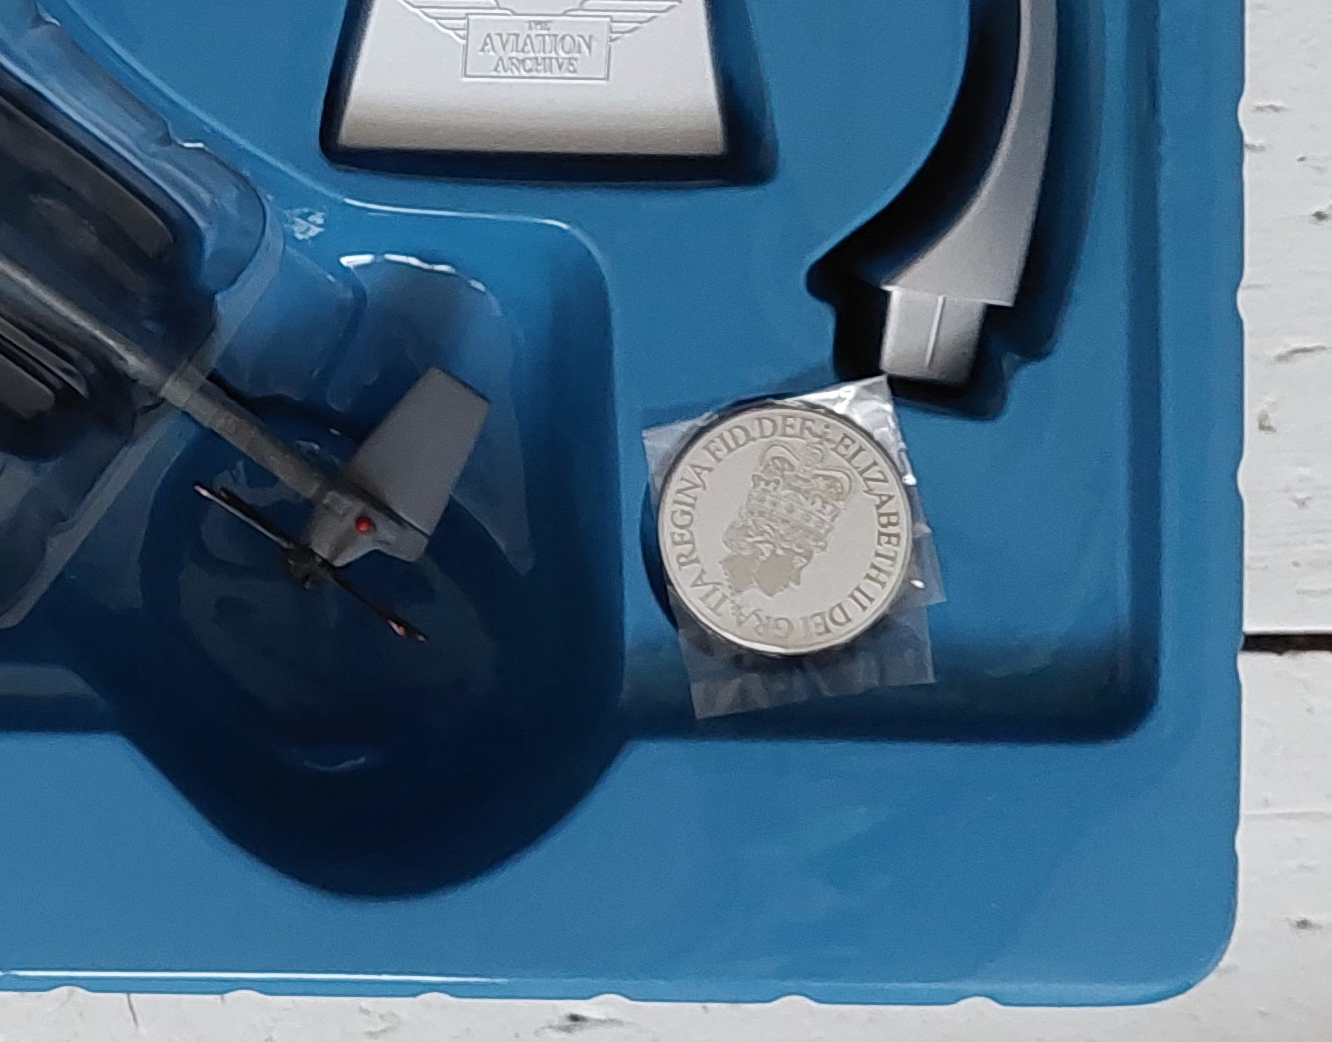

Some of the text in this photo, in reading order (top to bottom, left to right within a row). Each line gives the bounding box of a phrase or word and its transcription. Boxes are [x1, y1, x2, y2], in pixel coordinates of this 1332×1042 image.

[479, 33, 593, 55] AVIATION
[493, 56, 578, 74] ARCHIVE
[669, 464, 713, 570] REGINA
[833, 433, 899, 589] ELIZABETH
[690, 568, 794, 639] GRATIA
[847, 589, 875, 612] II
[801, 611, 852, 637] DEI
